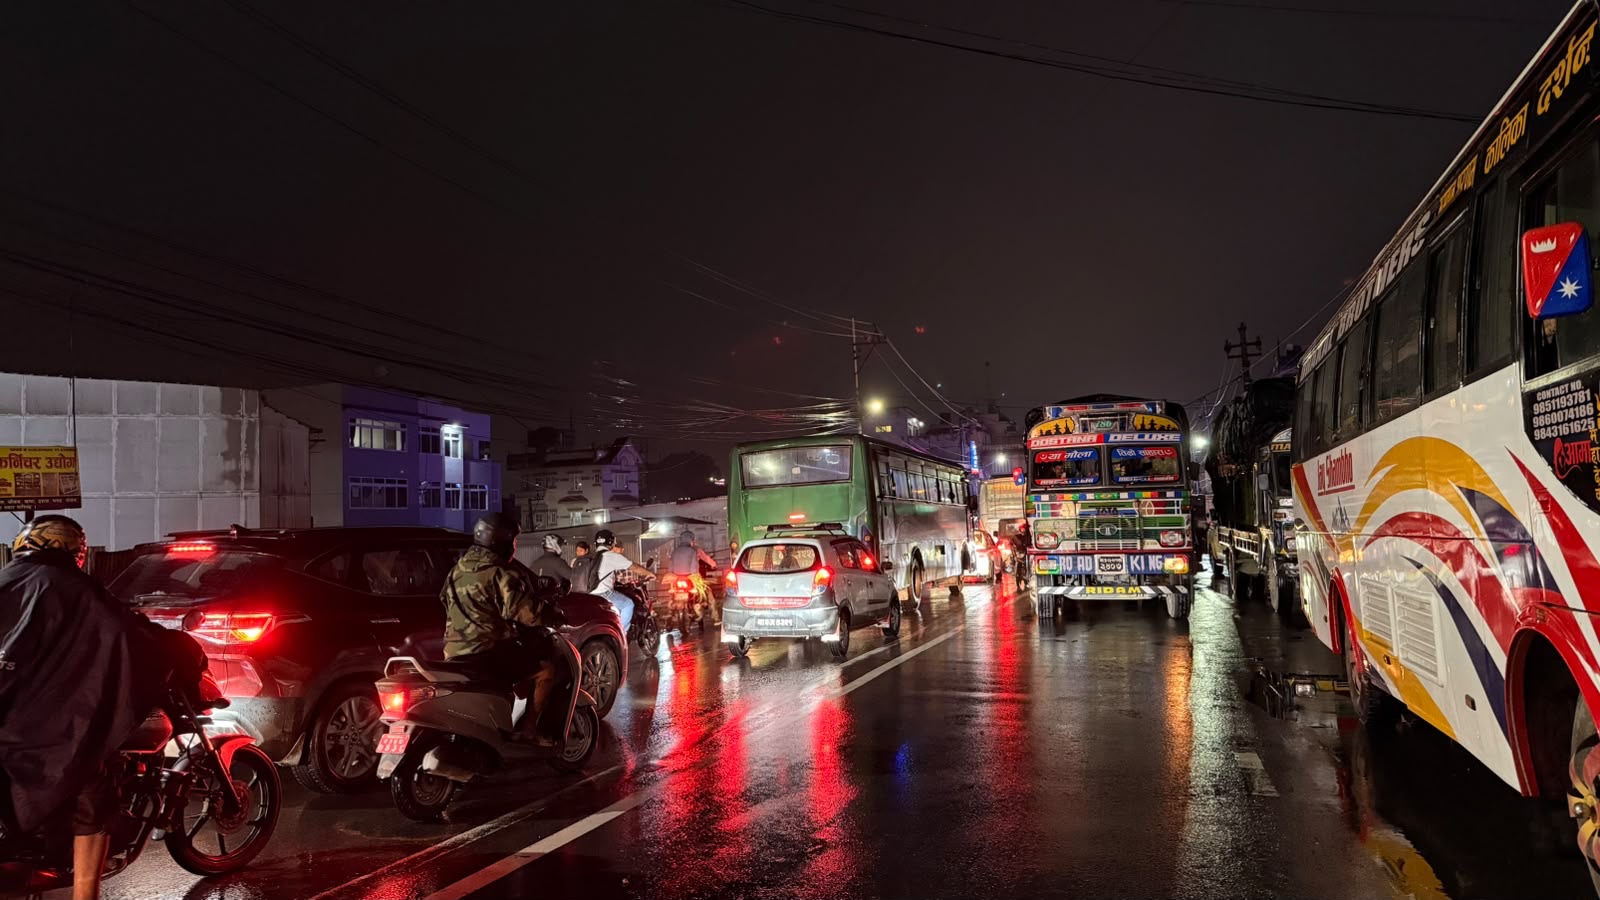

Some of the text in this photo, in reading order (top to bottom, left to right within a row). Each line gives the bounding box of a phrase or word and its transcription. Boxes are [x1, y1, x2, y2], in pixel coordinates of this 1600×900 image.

[1532, 388, 1592, 415] 9851193781
[1536, 380, 1585, 402] CONTACT NO.
[1532, 402, 1594, 428] 9860074186
[1030, 433, 1182, 447] DOSTANA DELUXE
[1534, 418, 1595, 440] 9843161625
[1085, 586, 1142, 595] RIDAM
